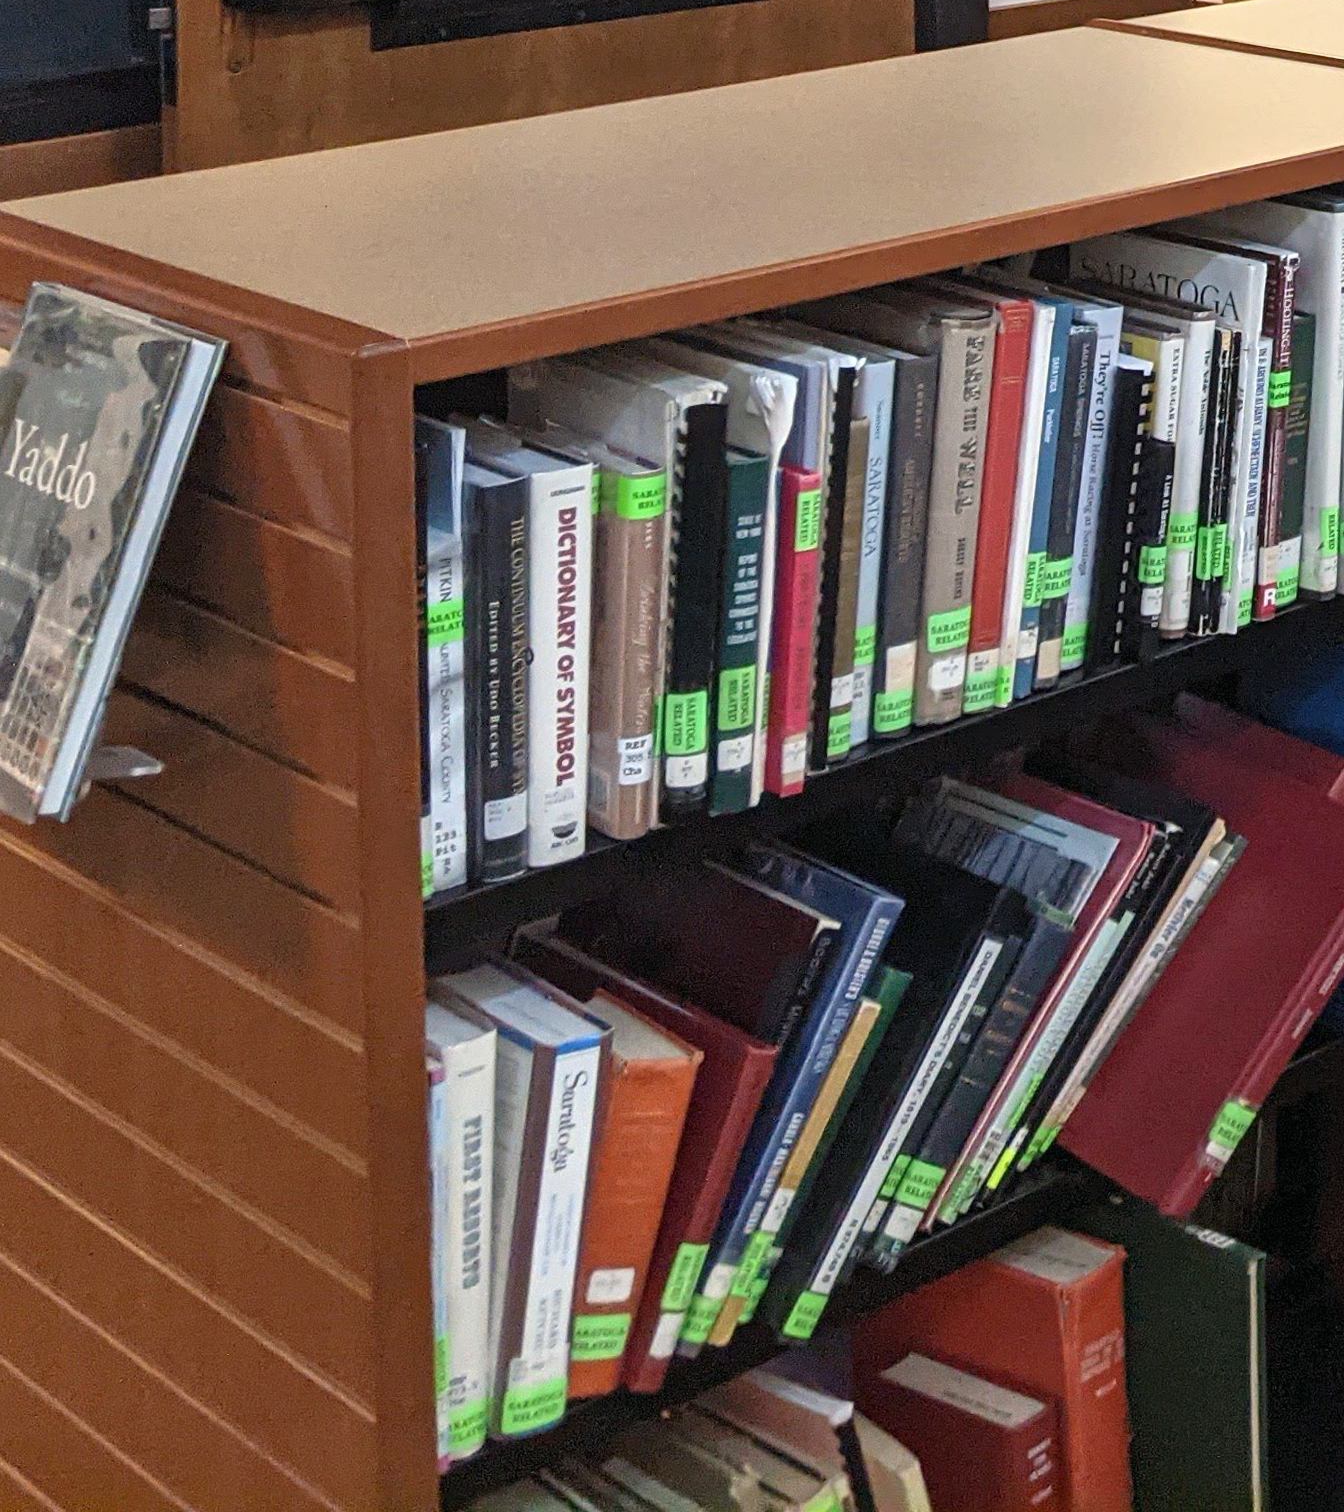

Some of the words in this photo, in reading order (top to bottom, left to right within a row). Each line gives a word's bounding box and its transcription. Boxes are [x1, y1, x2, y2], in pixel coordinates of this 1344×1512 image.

[1081, 255, 1241, 323] SARATOGA
[963, 336, 985, 403] FARE
[1094, 349, 1112, 406] They're
[1169, 347, 1182, 381] EXTRA
[1089, 408, 1107, 440] Off!
[1168, 384, 1180, 425] SUGAR
[4, 416, 98, 511] Yaddo
[954, 437, 978, 516] WELL
[1089, 444, 1101, 475] Horse
[864, 456, 883, 559] SARATOGA
[1083, 476, 1099, 514] Racing
[1077, 529, 1092, 577] Saratoga
[1327, 513, 1336, 551] RELATED
[510, 547, 527, 638] CONTINUUM
[556, 506, 578, 651] DICTIONARY
[1263, 587, 1277, 607] R
[487, 600, 501, 653] EDITED
[488, 656, 501, 675] BY
[556, 654, 575, 684] OF
[488, 679, 501, 713] UDO
[489, 715, 502, 769] BECKER
[625, 739, 647, 751] REF
[672, 703, 684, 747] RELATED
[685, 696, 698, 752] SARATOGA
[970, 951, 993, 996] DANIEL
[940, 994, 972, 1051] BENEDICT'S
[549, 1069, 589, 1175] Saratoga
[462, 1114, 483, 1185] FIRST
[461, 1187, 482, 1290] RESORTS
[508, 1390, 564, 1412] SARATOGA
[512, 1402, 560, 1424] RELATED
